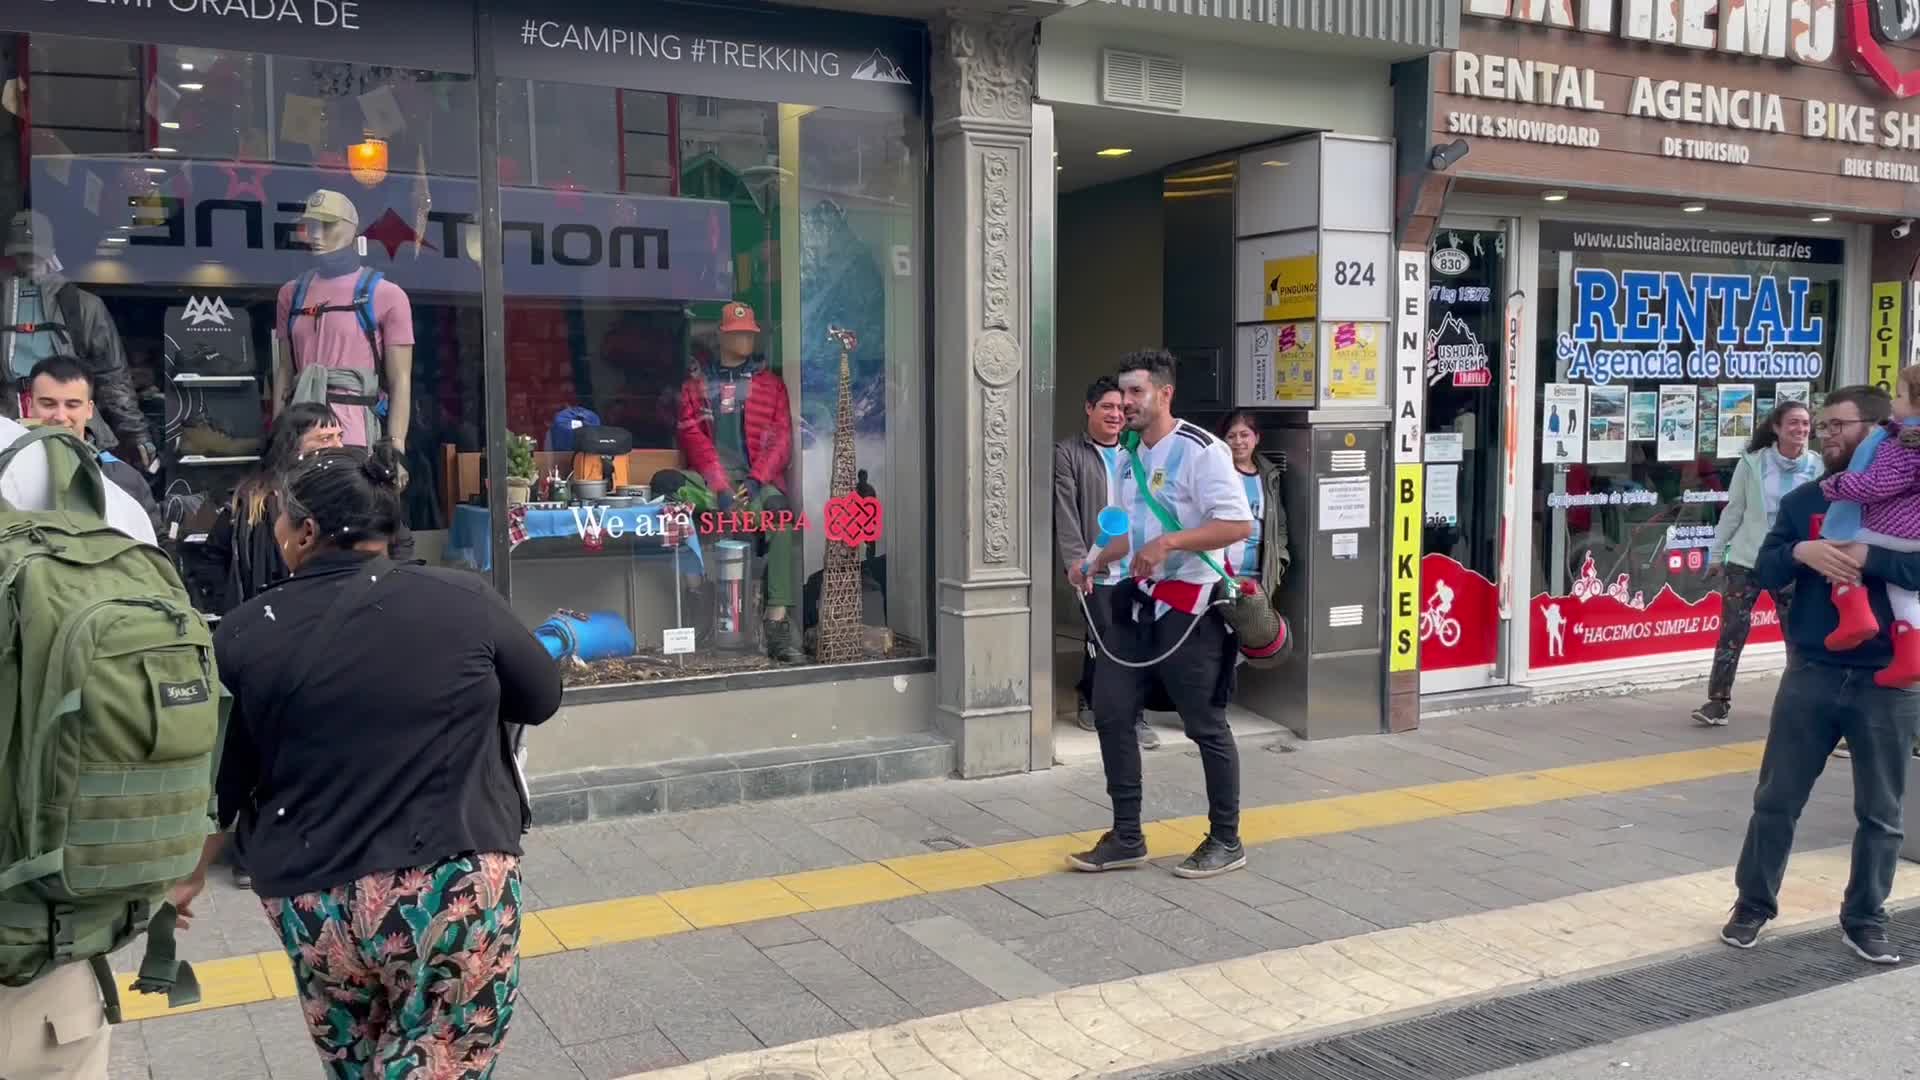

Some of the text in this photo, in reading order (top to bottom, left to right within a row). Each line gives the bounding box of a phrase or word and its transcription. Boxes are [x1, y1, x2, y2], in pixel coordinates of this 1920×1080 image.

[313, 0, 360, 29] DE
[520, 19, 841, 77] #CAMPING #TREKKING
[1452, 50, 1604, 110] RENTAL
[1628, 76, 1785, 133] AGENCIA
[1449, 111, 1600, 147] SKI & SNOWBOARD
[1804, 99, 1875, 143] BIKE
[1664, 136, 1750, 163] DE TURISMO
[1844, 158, 1920, 182] BIKE RENTAL
[1574, 232, 1811, 259] www.ushuaiaextremoevt.tur.ar/es
[1335, 261, 1376, 286] 824
[1440, 260, 1462, 270] 830
[1574, 268, 1822, 344] RENTAL
[1400, 262, 1419, 452] RENTAL
[1438, 344, 1486, 359] USHUAIA
[1438, 359, 1486, 373] EXTREMO
[1557, 332, 1823, 385] & Agencia de turismo
[568, 506, 812, 538] We are SHERPA
[1397, 479, 1415, 655] BIKES
[1653, 618, 1700, 637] SIMPLE
[1702, 615, 1720, 632] LO
